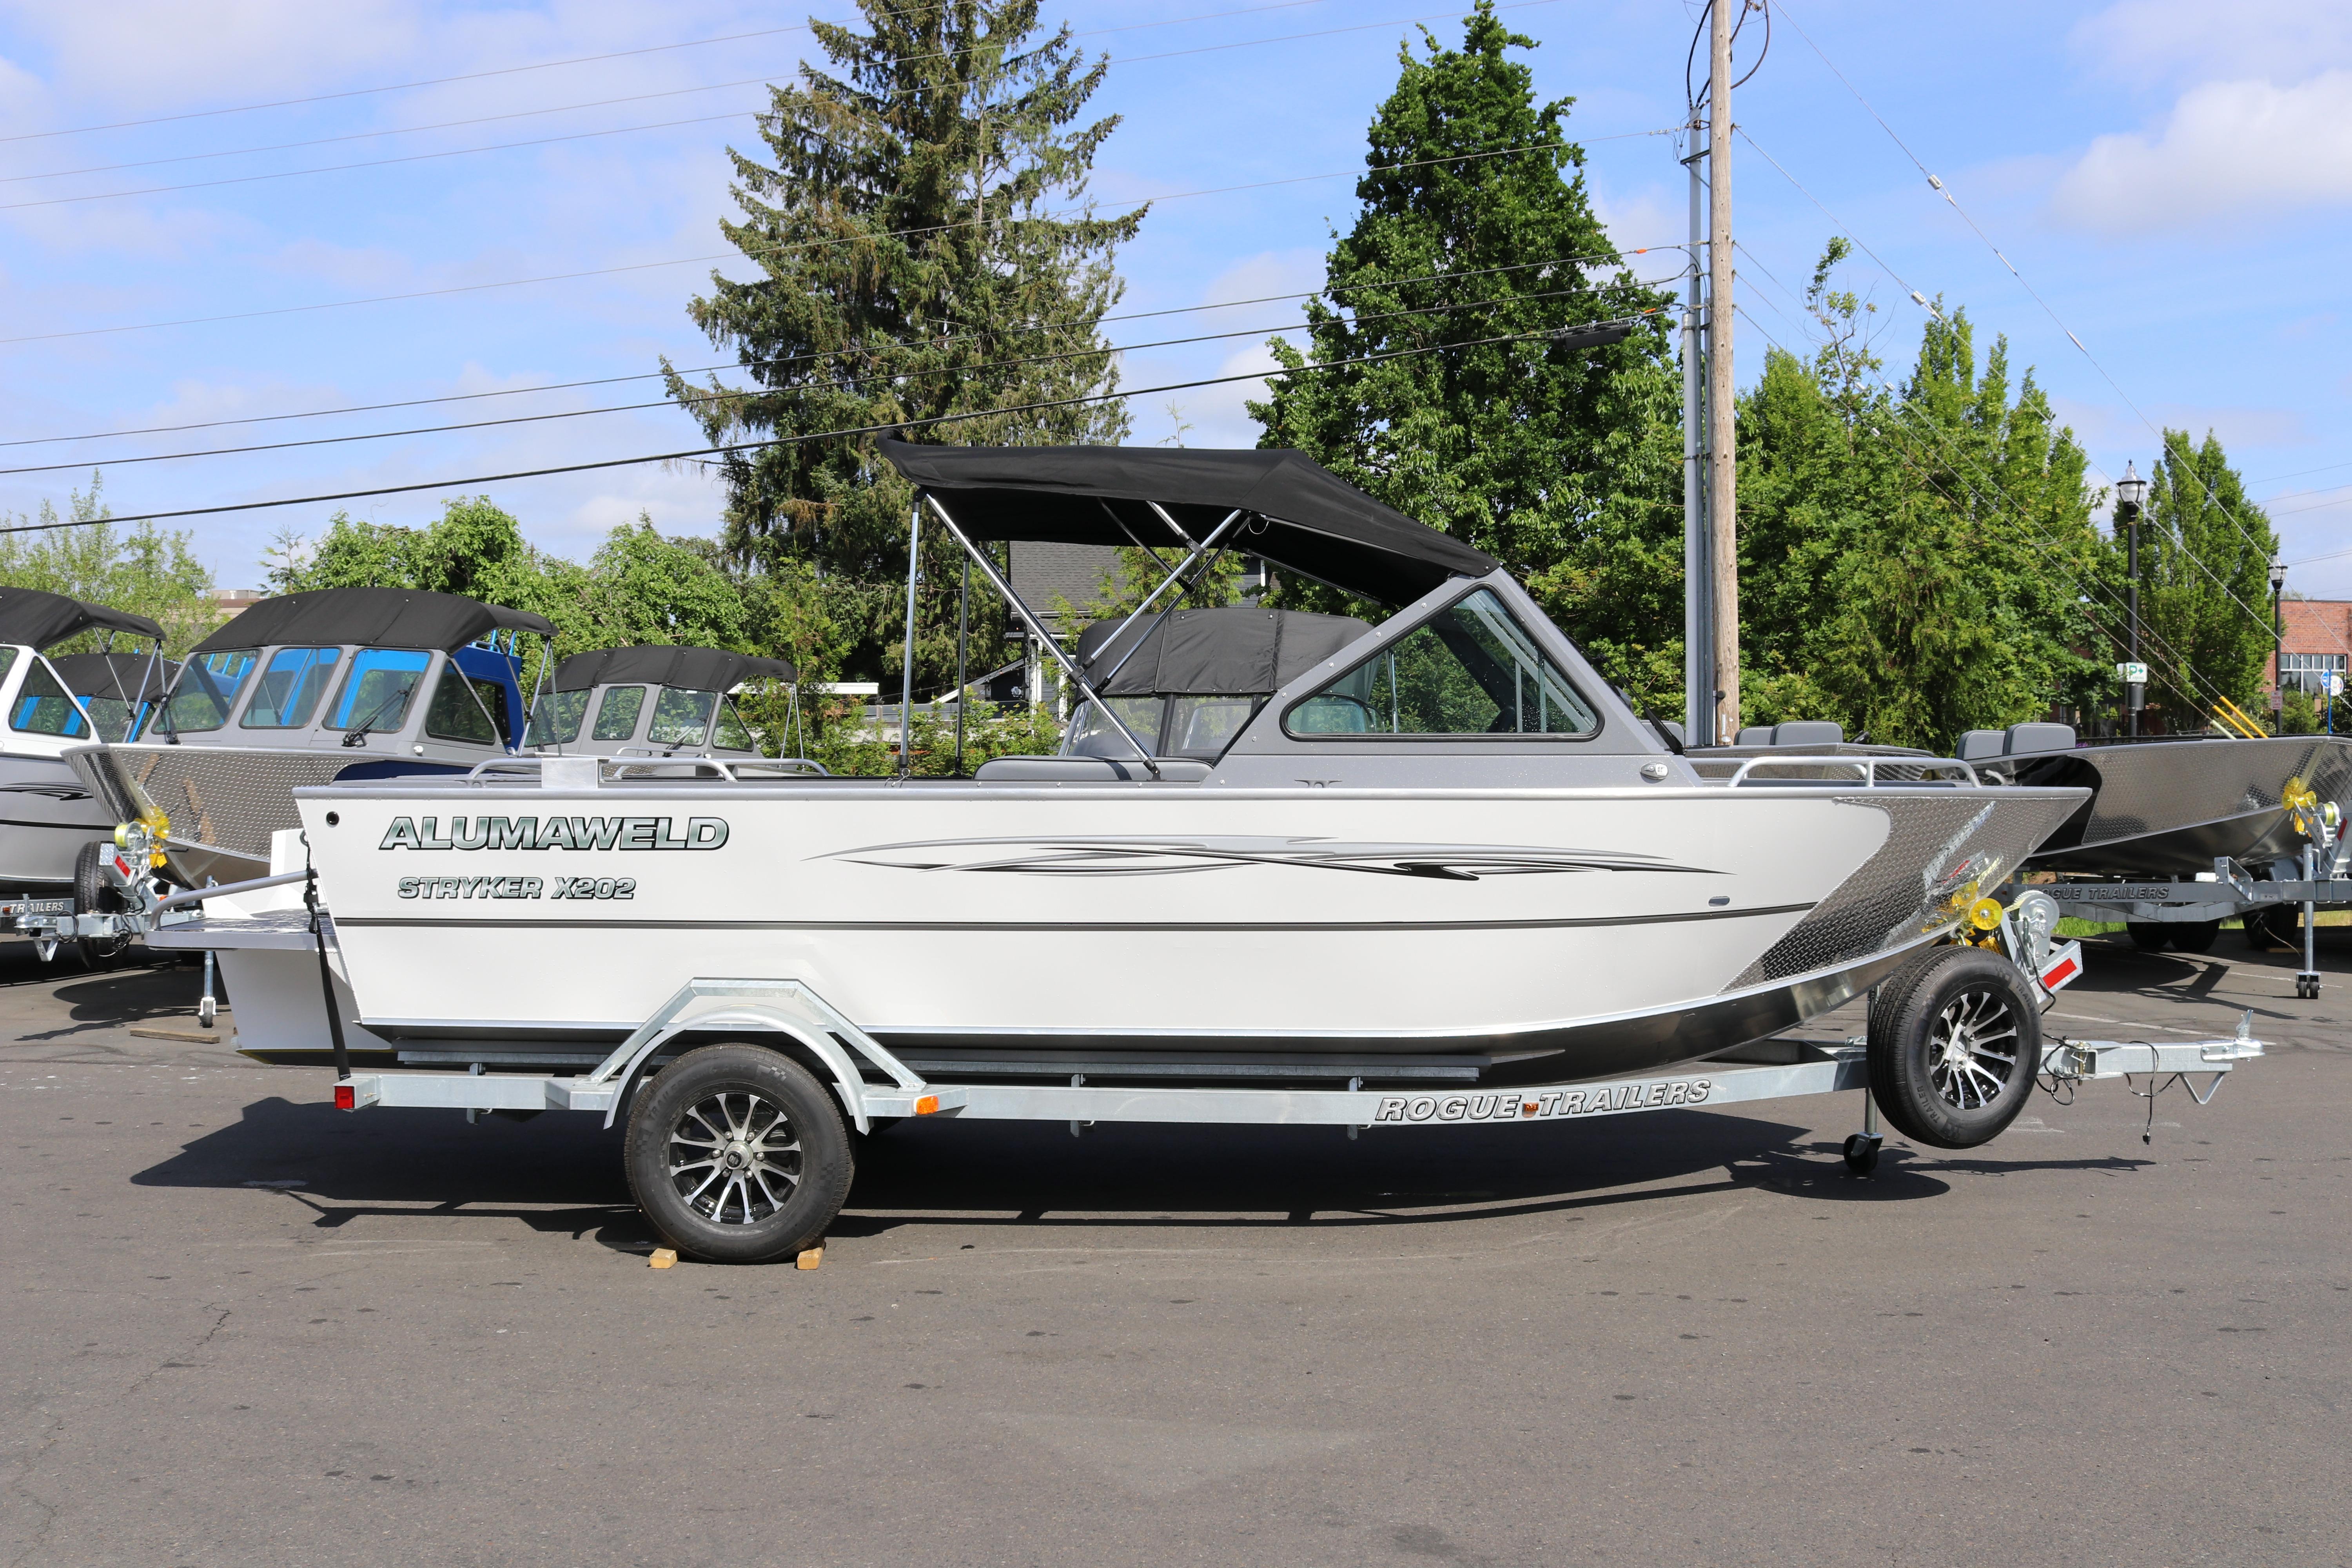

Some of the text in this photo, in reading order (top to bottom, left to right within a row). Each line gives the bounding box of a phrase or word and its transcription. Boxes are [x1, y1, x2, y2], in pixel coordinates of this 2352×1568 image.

[378, 816, 730, 851] ALUMAWELD
[397, 877, 636, 900] STRYKER X202
[2089, 887, 2169, 900] TRAILERS
[1375, 1079, 1711, 1122] ROGUE TRAILERS
[1916, 1085, 1940, 1123] TRAILER
